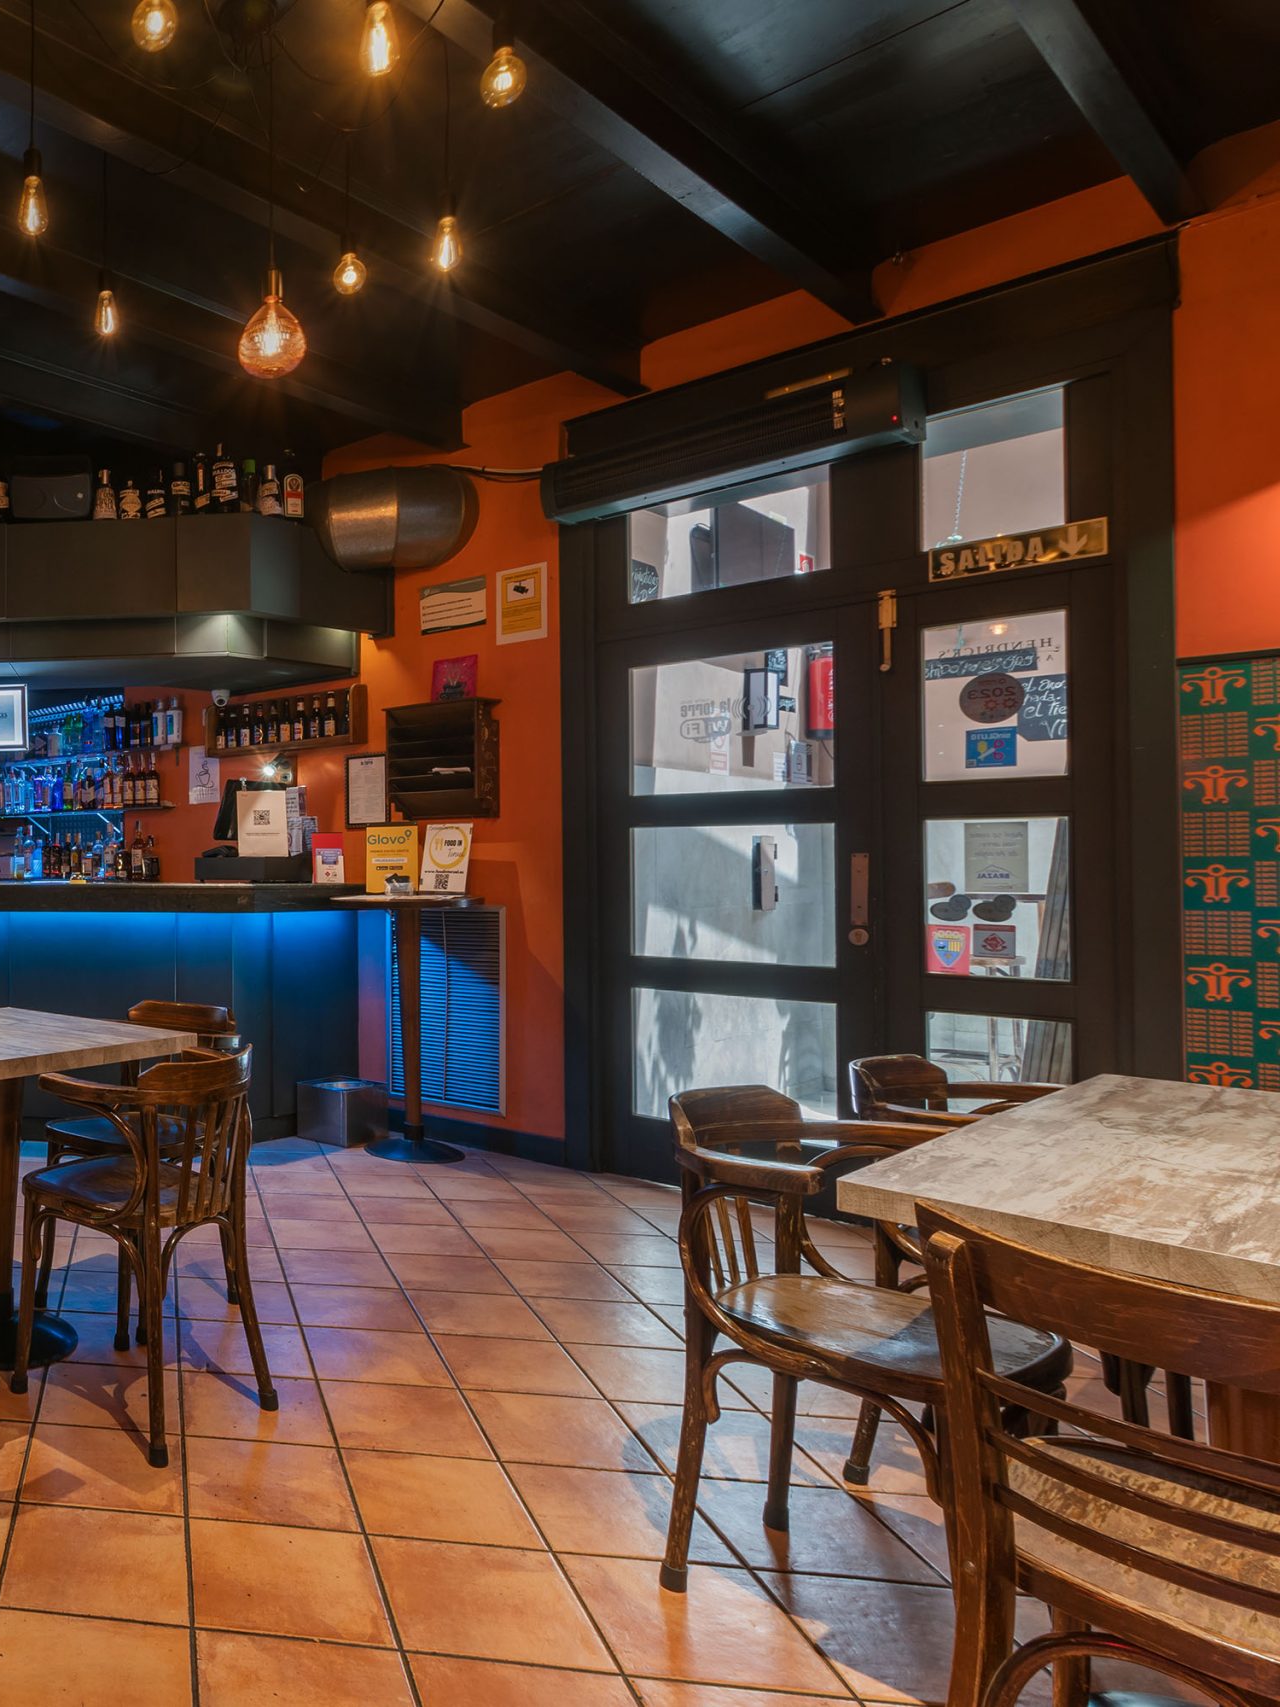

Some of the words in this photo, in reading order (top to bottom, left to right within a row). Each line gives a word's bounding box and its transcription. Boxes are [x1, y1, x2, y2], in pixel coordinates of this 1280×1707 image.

[939, 536, 1045, 573] SALIDA
[367, 834, 407, 845] Glovo
[444, 839, 456, 847] FOOD
